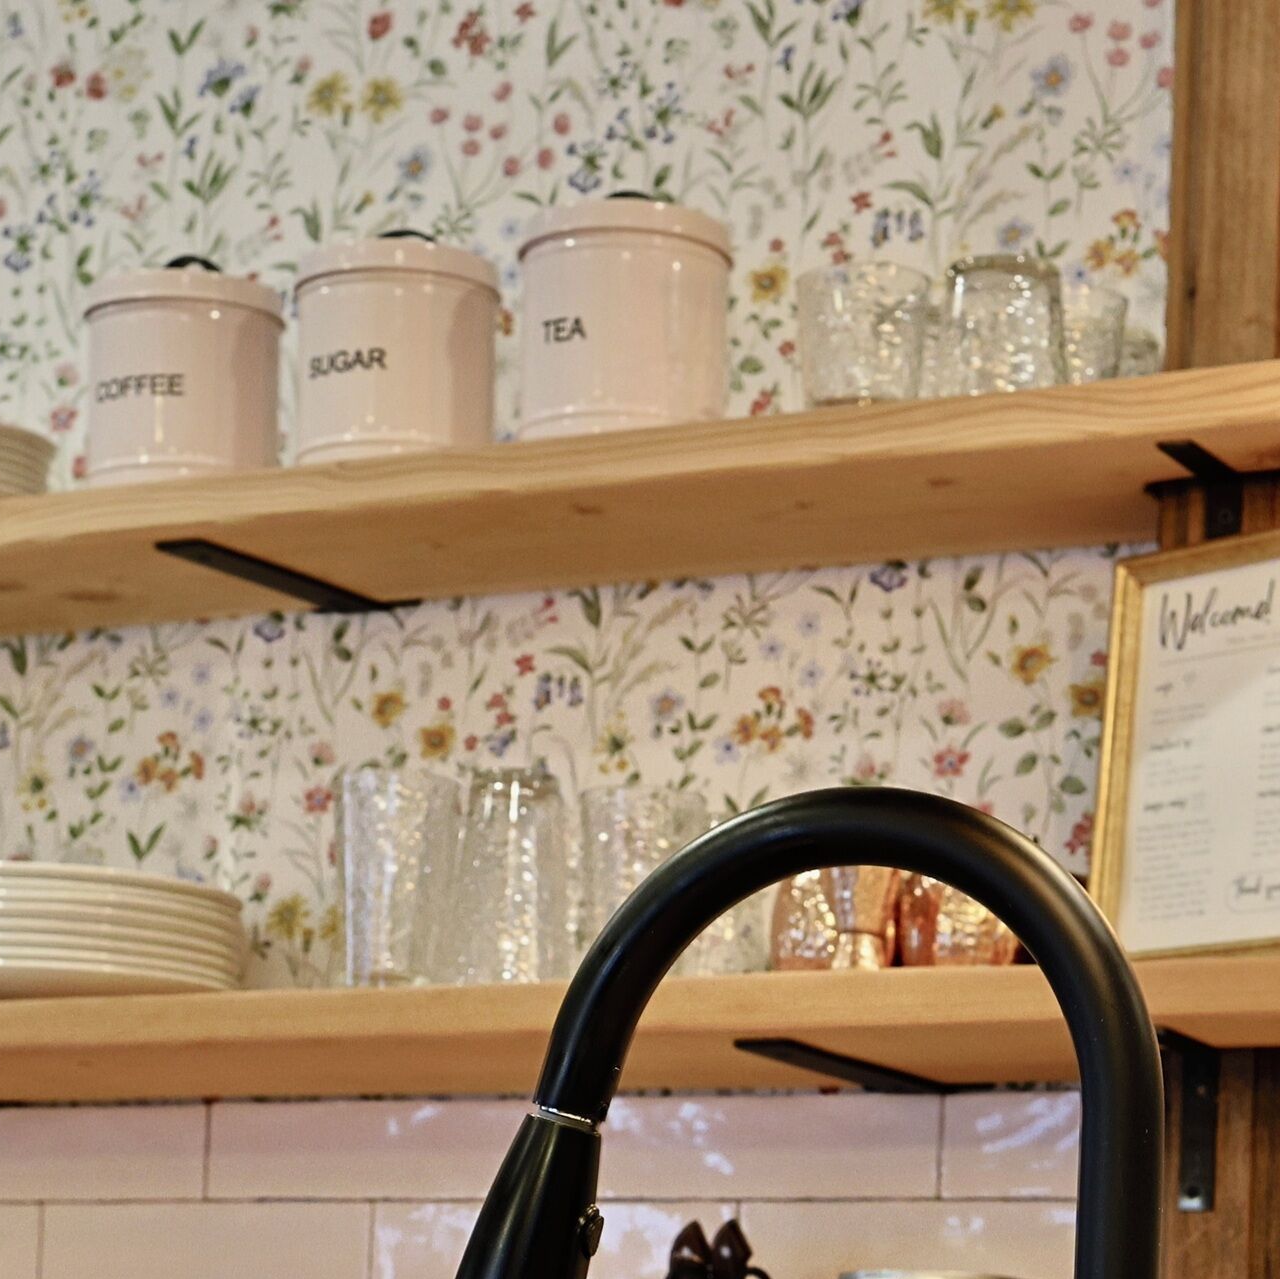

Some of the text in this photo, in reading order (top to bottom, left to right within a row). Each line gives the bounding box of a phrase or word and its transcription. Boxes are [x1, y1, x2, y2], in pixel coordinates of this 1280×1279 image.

[542, 317, 587, 344] TEA
[308, 347, 388, 379] SUGAR
[94, 372, 186, 403] COFFEE
